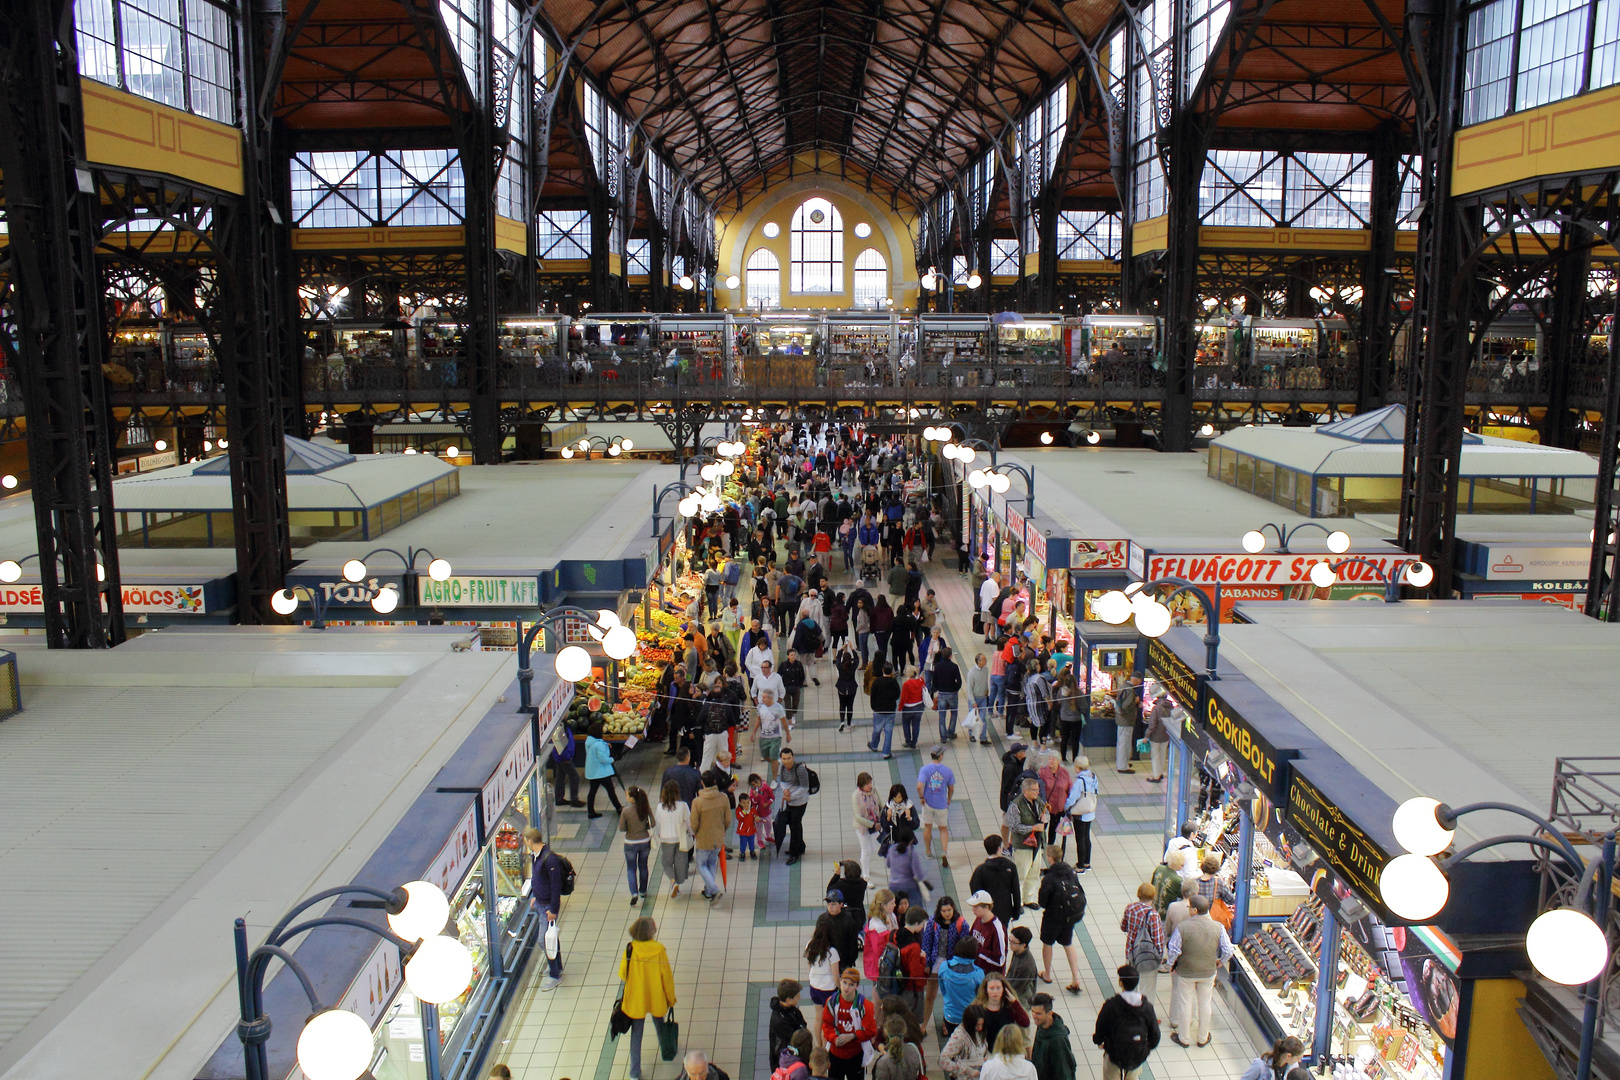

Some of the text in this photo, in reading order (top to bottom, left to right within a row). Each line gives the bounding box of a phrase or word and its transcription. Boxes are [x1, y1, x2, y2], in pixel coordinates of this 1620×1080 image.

[1150, 556, 1282, 581] FELVÁGOTT
[1290, 556, 1418, 581] SZKÜZLE
[0, 586, 174, 605] LDSÉ MÖLCS
[424, 579, 538, 603] AGRO-FRUIT KFT.
[1290, 784, 1335, 840] Chocolate
[1338, 833, 1346, 850] &
